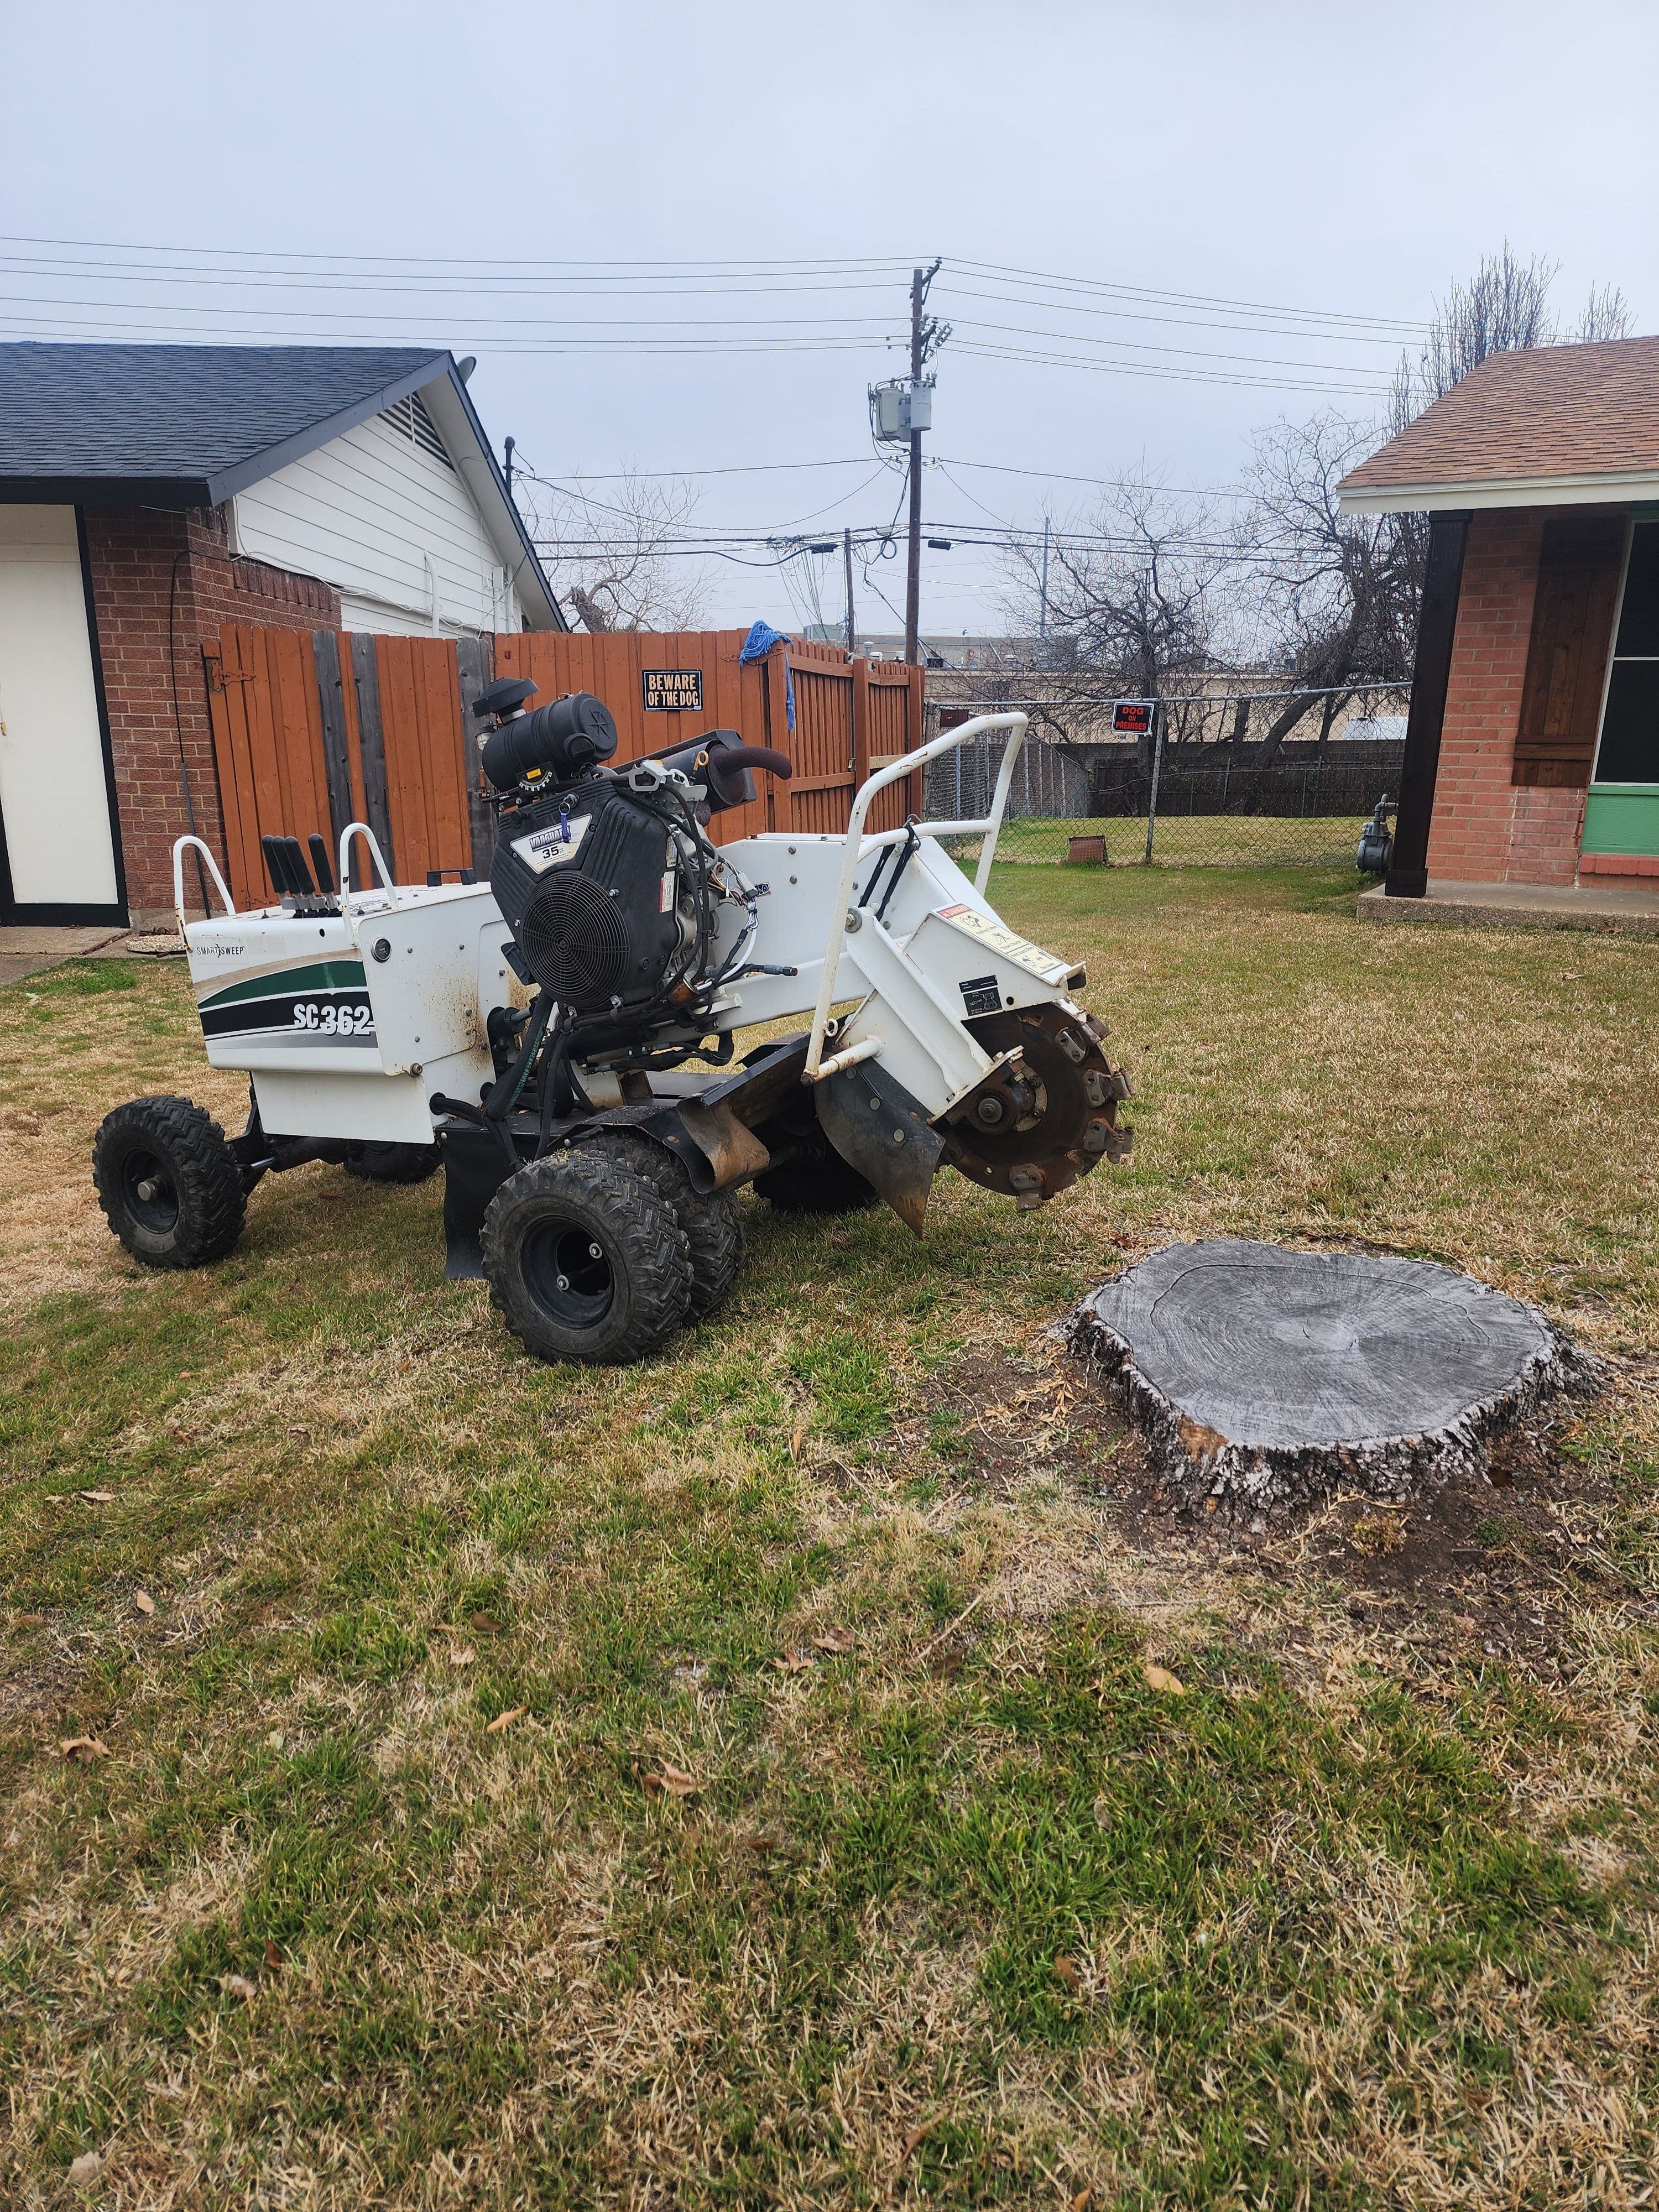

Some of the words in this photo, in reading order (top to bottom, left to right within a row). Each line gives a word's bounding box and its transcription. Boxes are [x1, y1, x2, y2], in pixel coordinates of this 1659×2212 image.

[649, 674, 696, 690] BEWARE
[648, 691, 660, 706] OF
[661, 691, 679, 706] THE
[680, 691, 698, 706] DOG
[1122, 706, 1144, 715] DOG
[1115, 721, 1147, 731] PREMISES
[542, 846, 559, 859] 35
[294, 1004, 370, 1036] SC362
